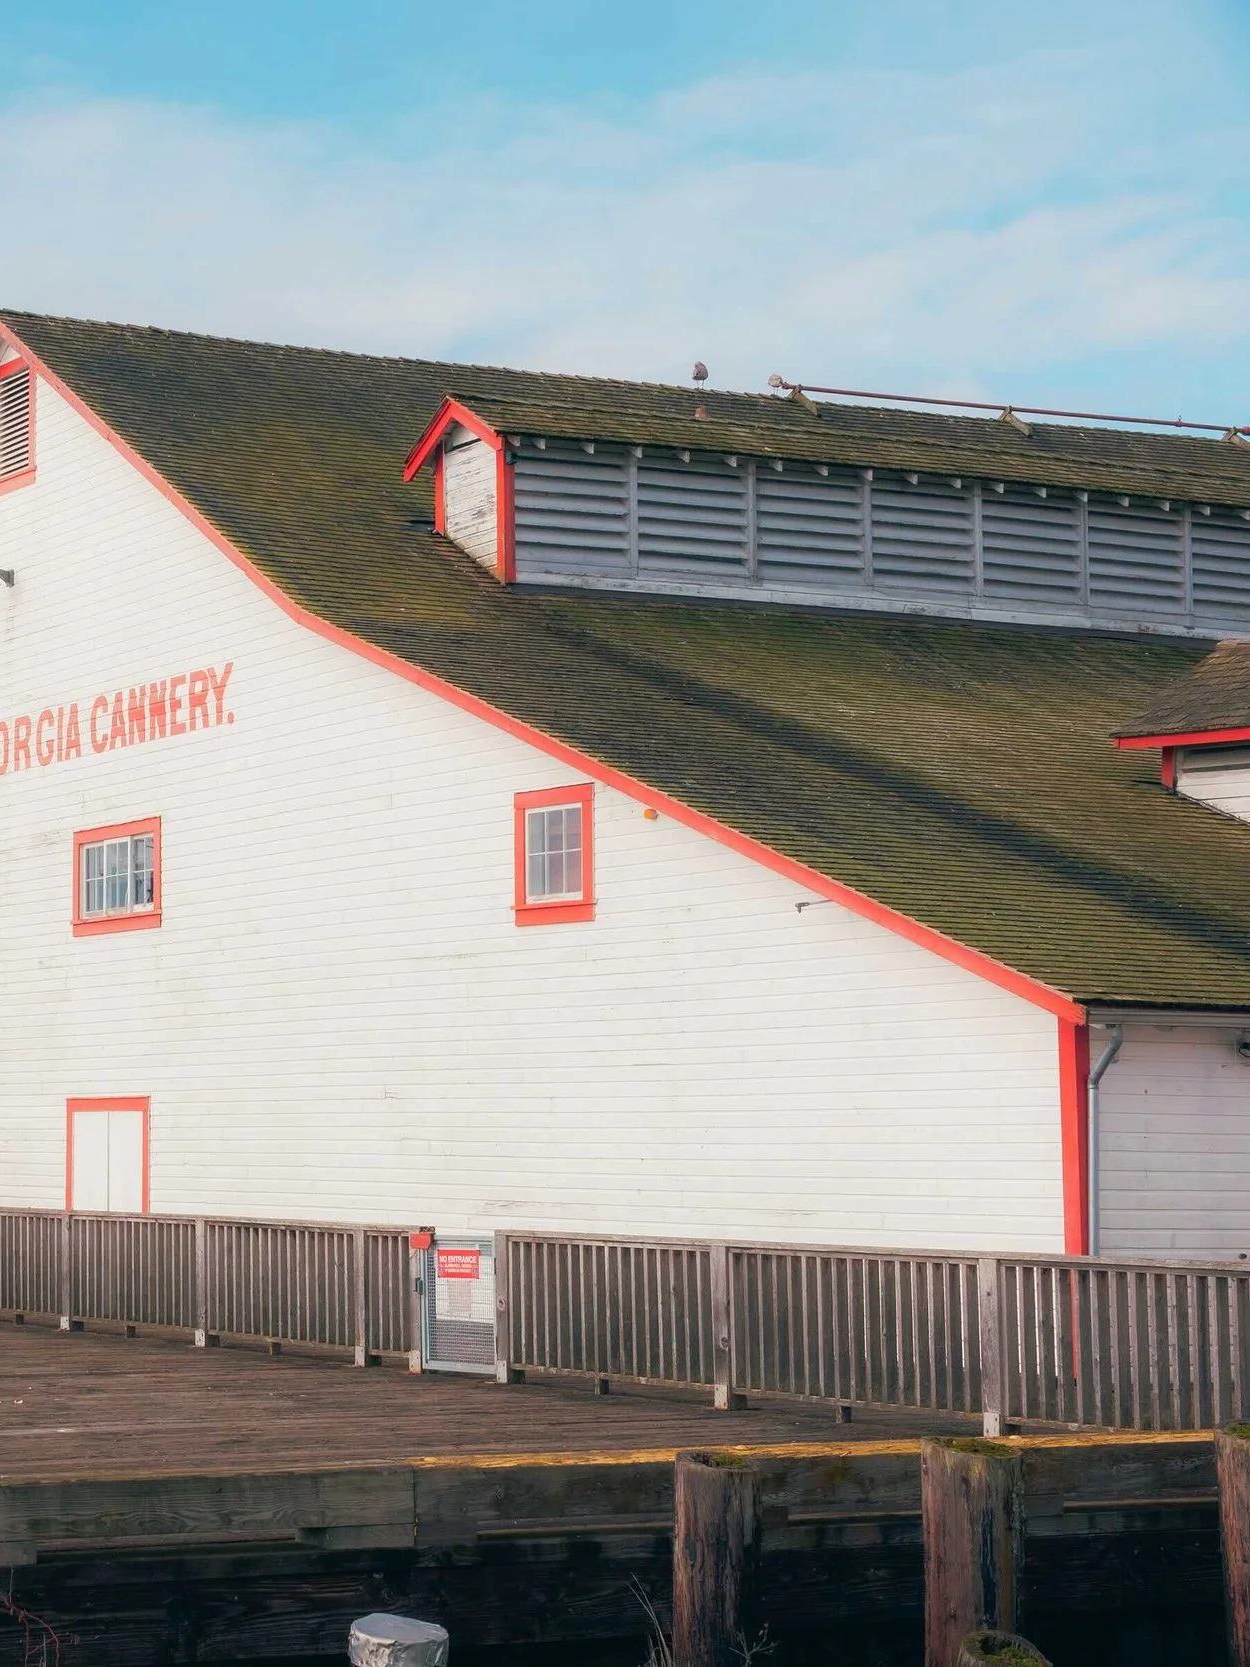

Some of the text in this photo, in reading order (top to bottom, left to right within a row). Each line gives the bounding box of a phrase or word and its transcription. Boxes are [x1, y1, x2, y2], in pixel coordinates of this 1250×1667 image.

[90, 662, 235, 753] CANNERY.
[439, 1255, 477, 1263] NO ENTRANCE
